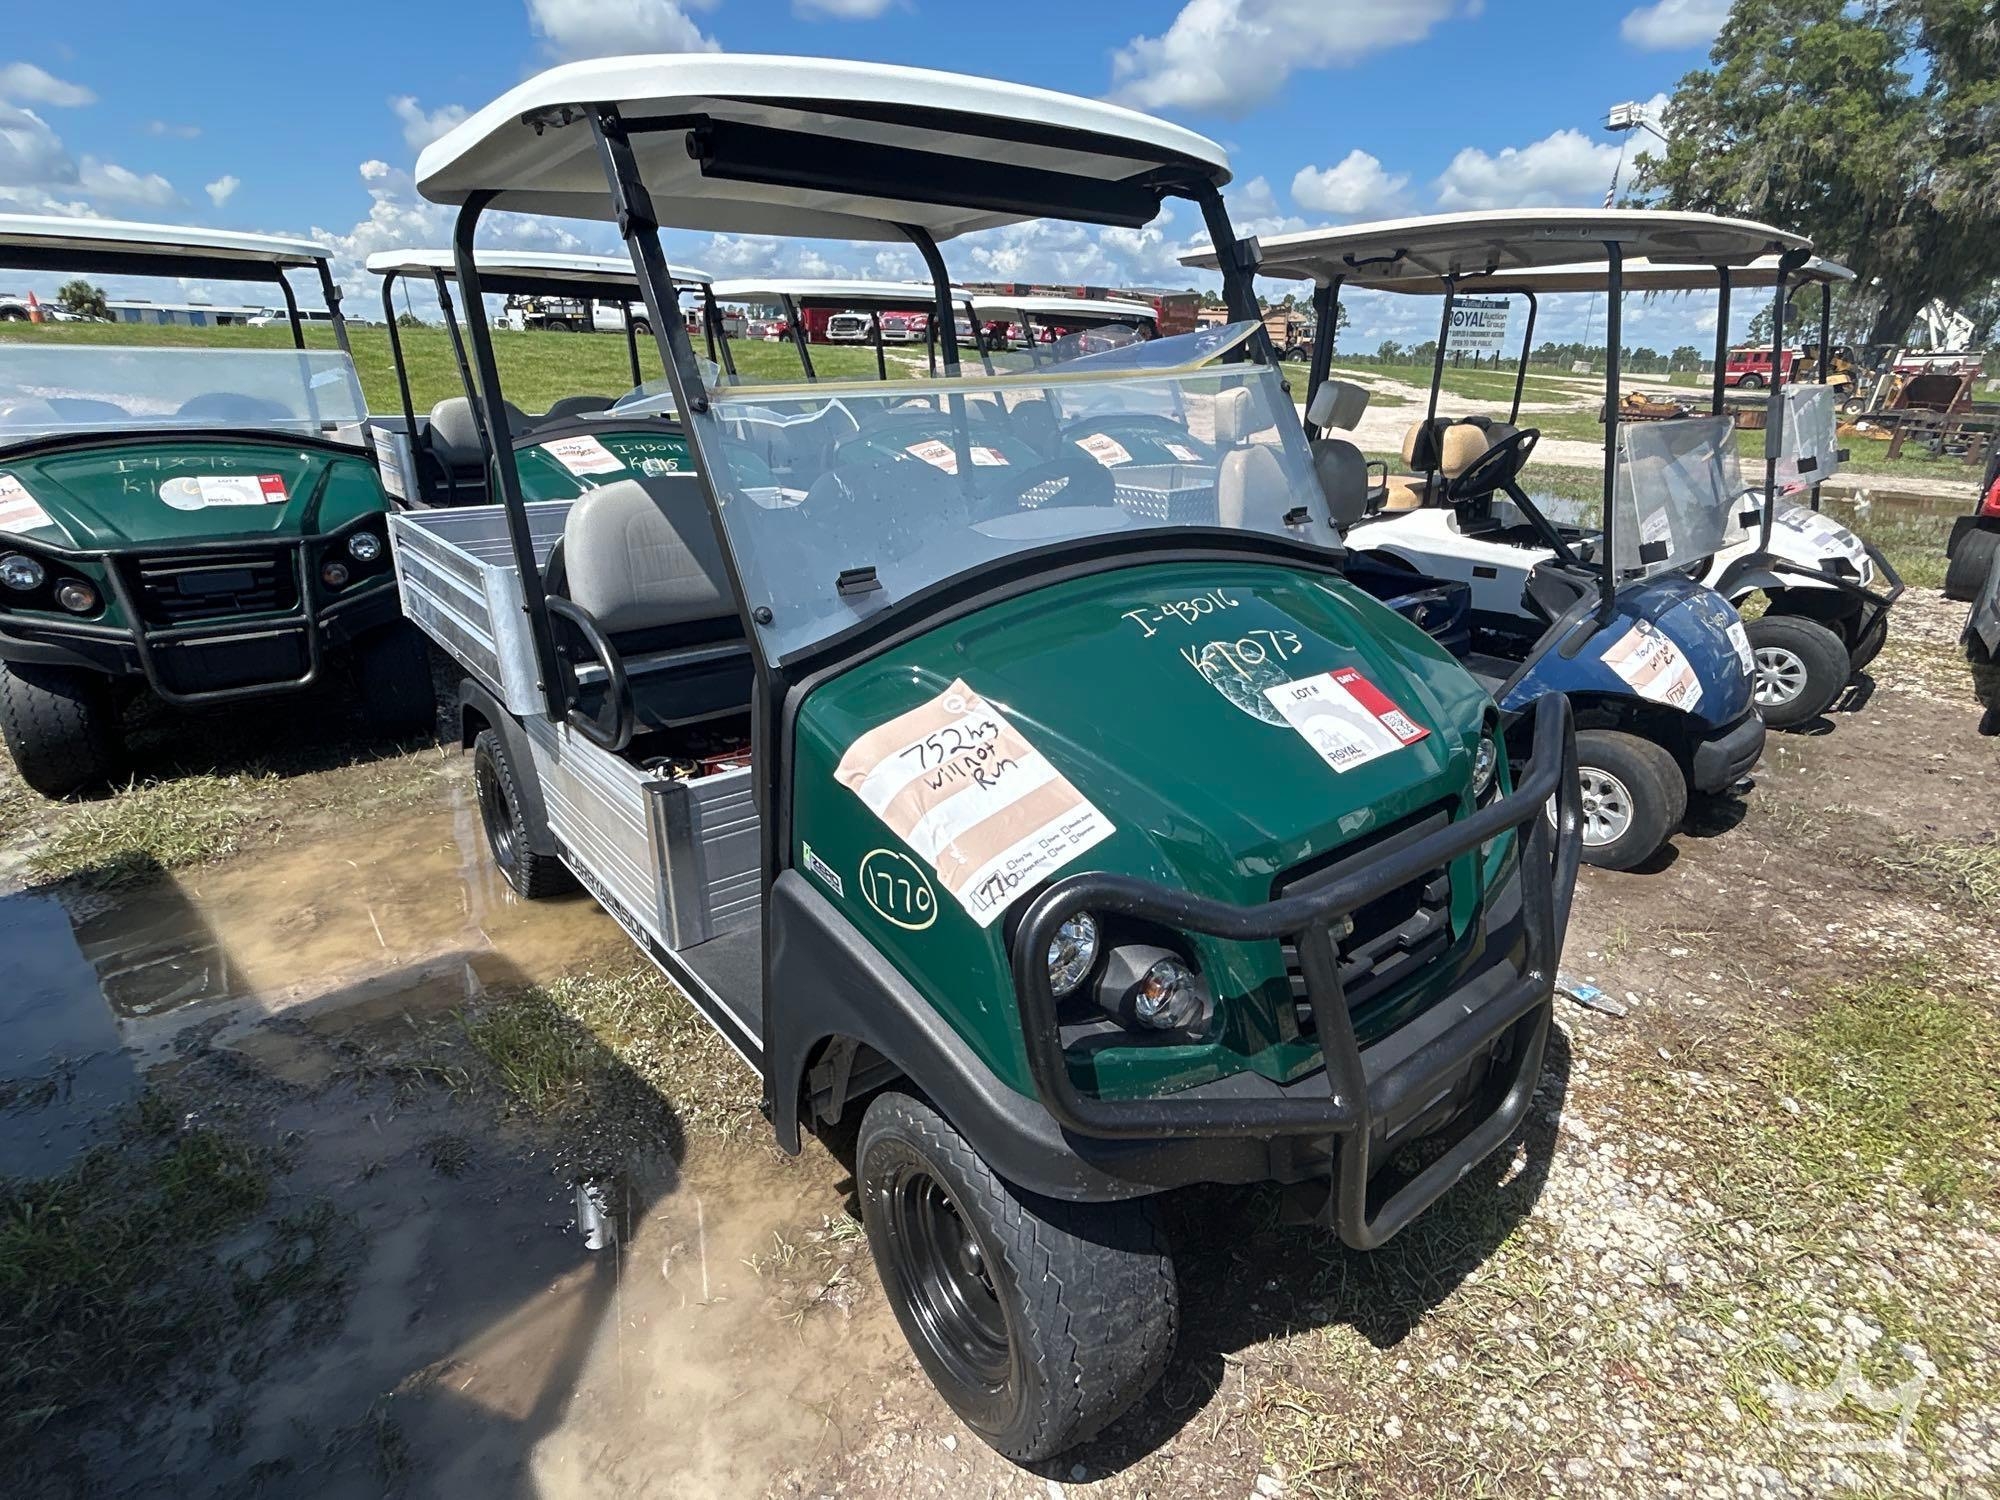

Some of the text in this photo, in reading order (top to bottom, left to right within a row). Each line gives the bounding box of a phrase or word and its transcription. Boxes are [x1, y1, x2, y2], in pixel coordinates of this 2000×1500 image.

[1484, 311, 1507, 320] Auction
[1486, 320, 1506, 329] Group
[1121, 588, 1240, 638] I-43016
[1290, 687, 1313, 700] LOT
[899, 728, 976, 769] 752
[1327, 743, 1362, 763] ROYAL
[972, 758, 1019, 791] Run
[868, 865, 931, 913] 1770
